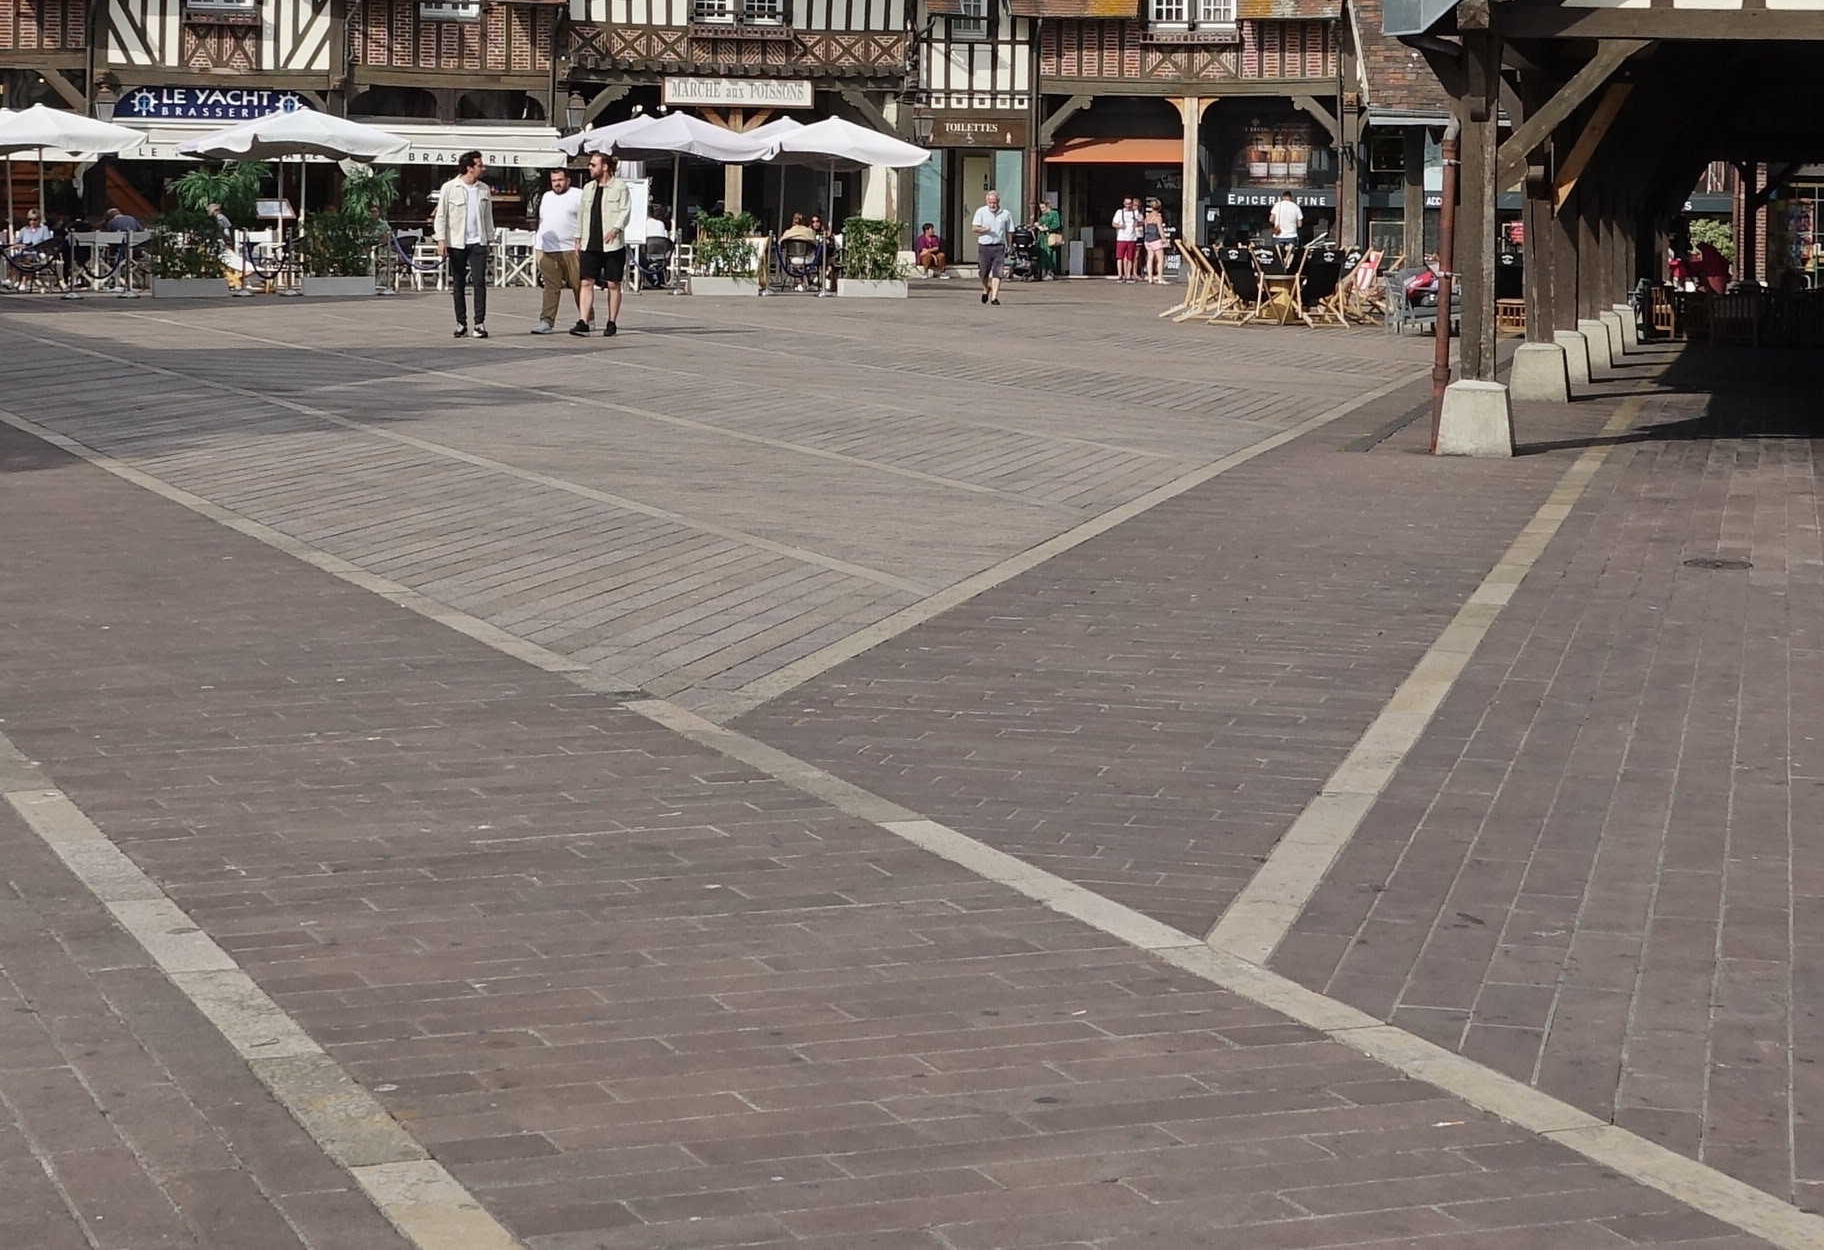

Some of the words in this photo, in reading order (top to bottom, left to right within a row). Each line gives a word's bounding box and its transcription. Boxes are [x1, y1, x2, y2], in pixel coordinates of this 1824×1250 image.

[162, 89, 186, 104] LE
[194, 89, 272, 106] YACHT
[726, 86, 744, 99] aux
[750, 83, 804, 100] POISSONS
[944, 122, 998, 132] TOILETTES
[138, 147, 157, 157] LE
[408, 152, 519, 164] BRASRIE
[1228, 194, 1281, 205] EPICERI
[1296, 196, 1326, 206] FINE
